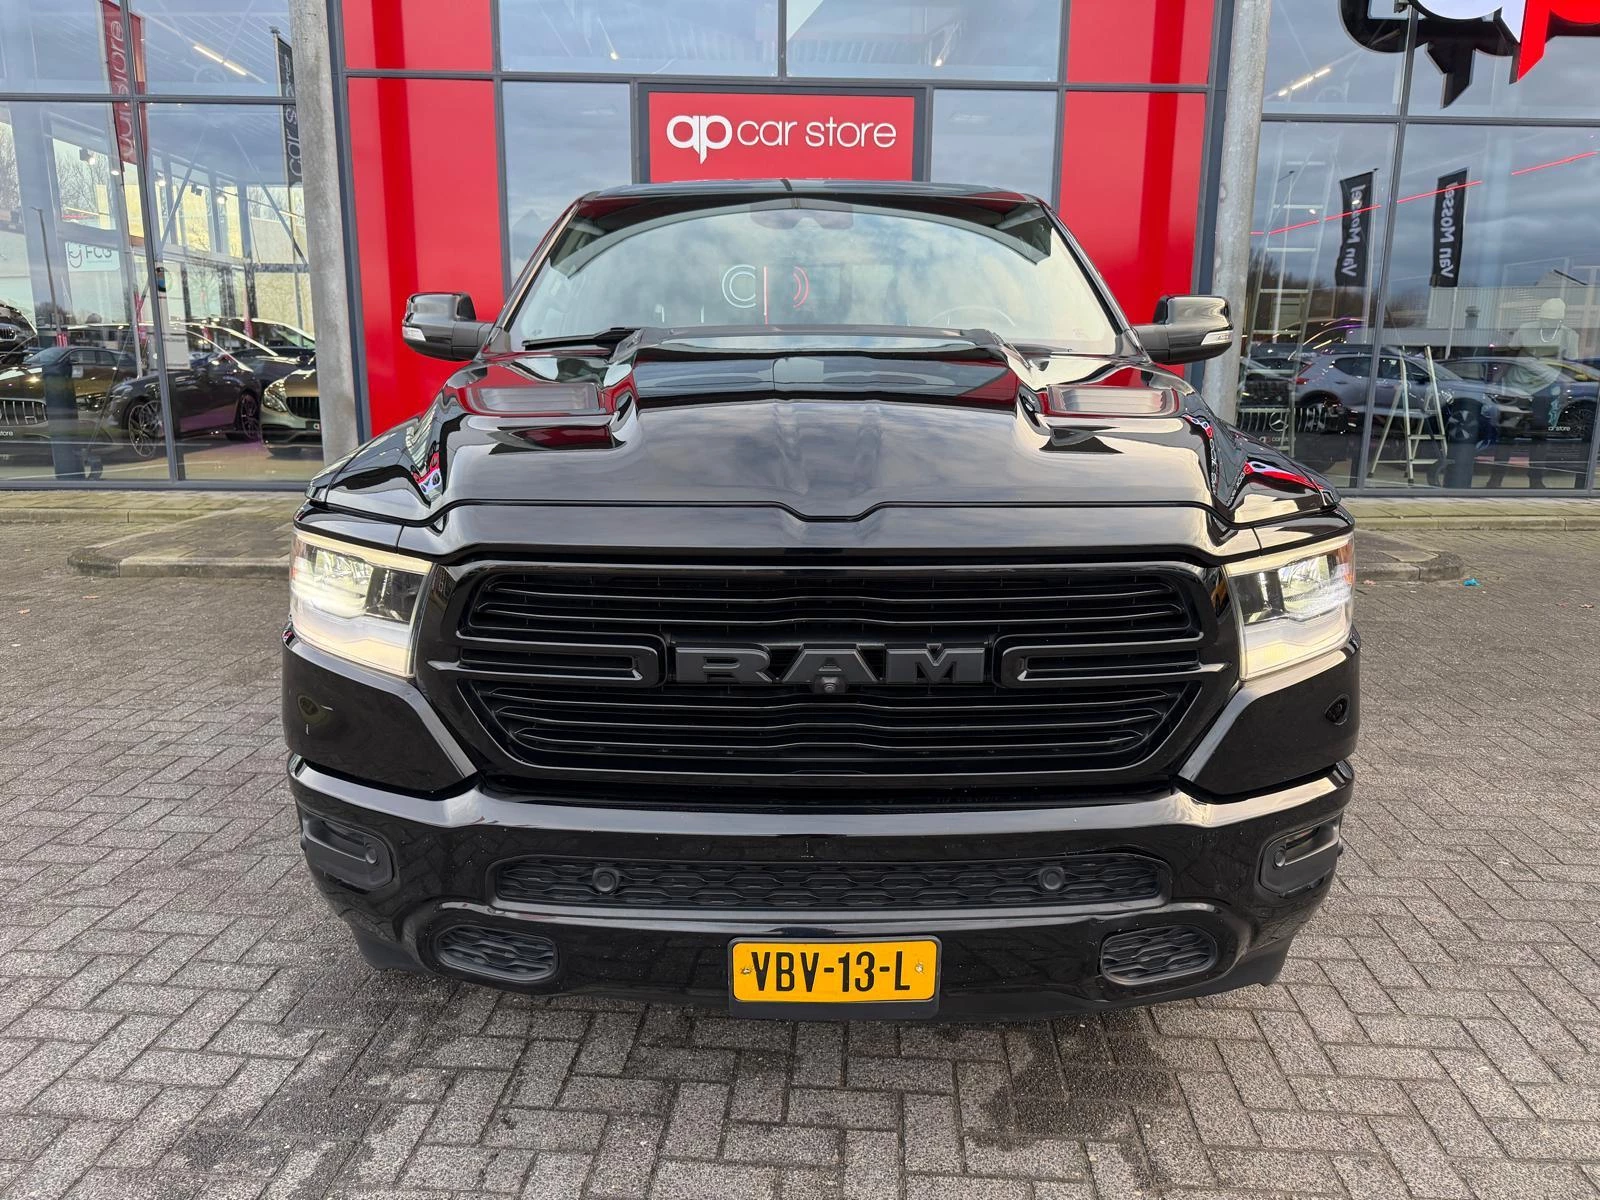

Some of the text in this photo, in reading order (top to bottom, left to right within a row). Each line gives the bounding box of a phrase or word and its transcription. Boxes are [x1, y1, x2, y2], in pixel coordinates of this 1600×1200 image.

[737, 120, 798, 146] car
[805, 116, 897, 148] store
[675, 645, 985, 684] RAM
[750, 950, 911, 993] VBV-13-L
